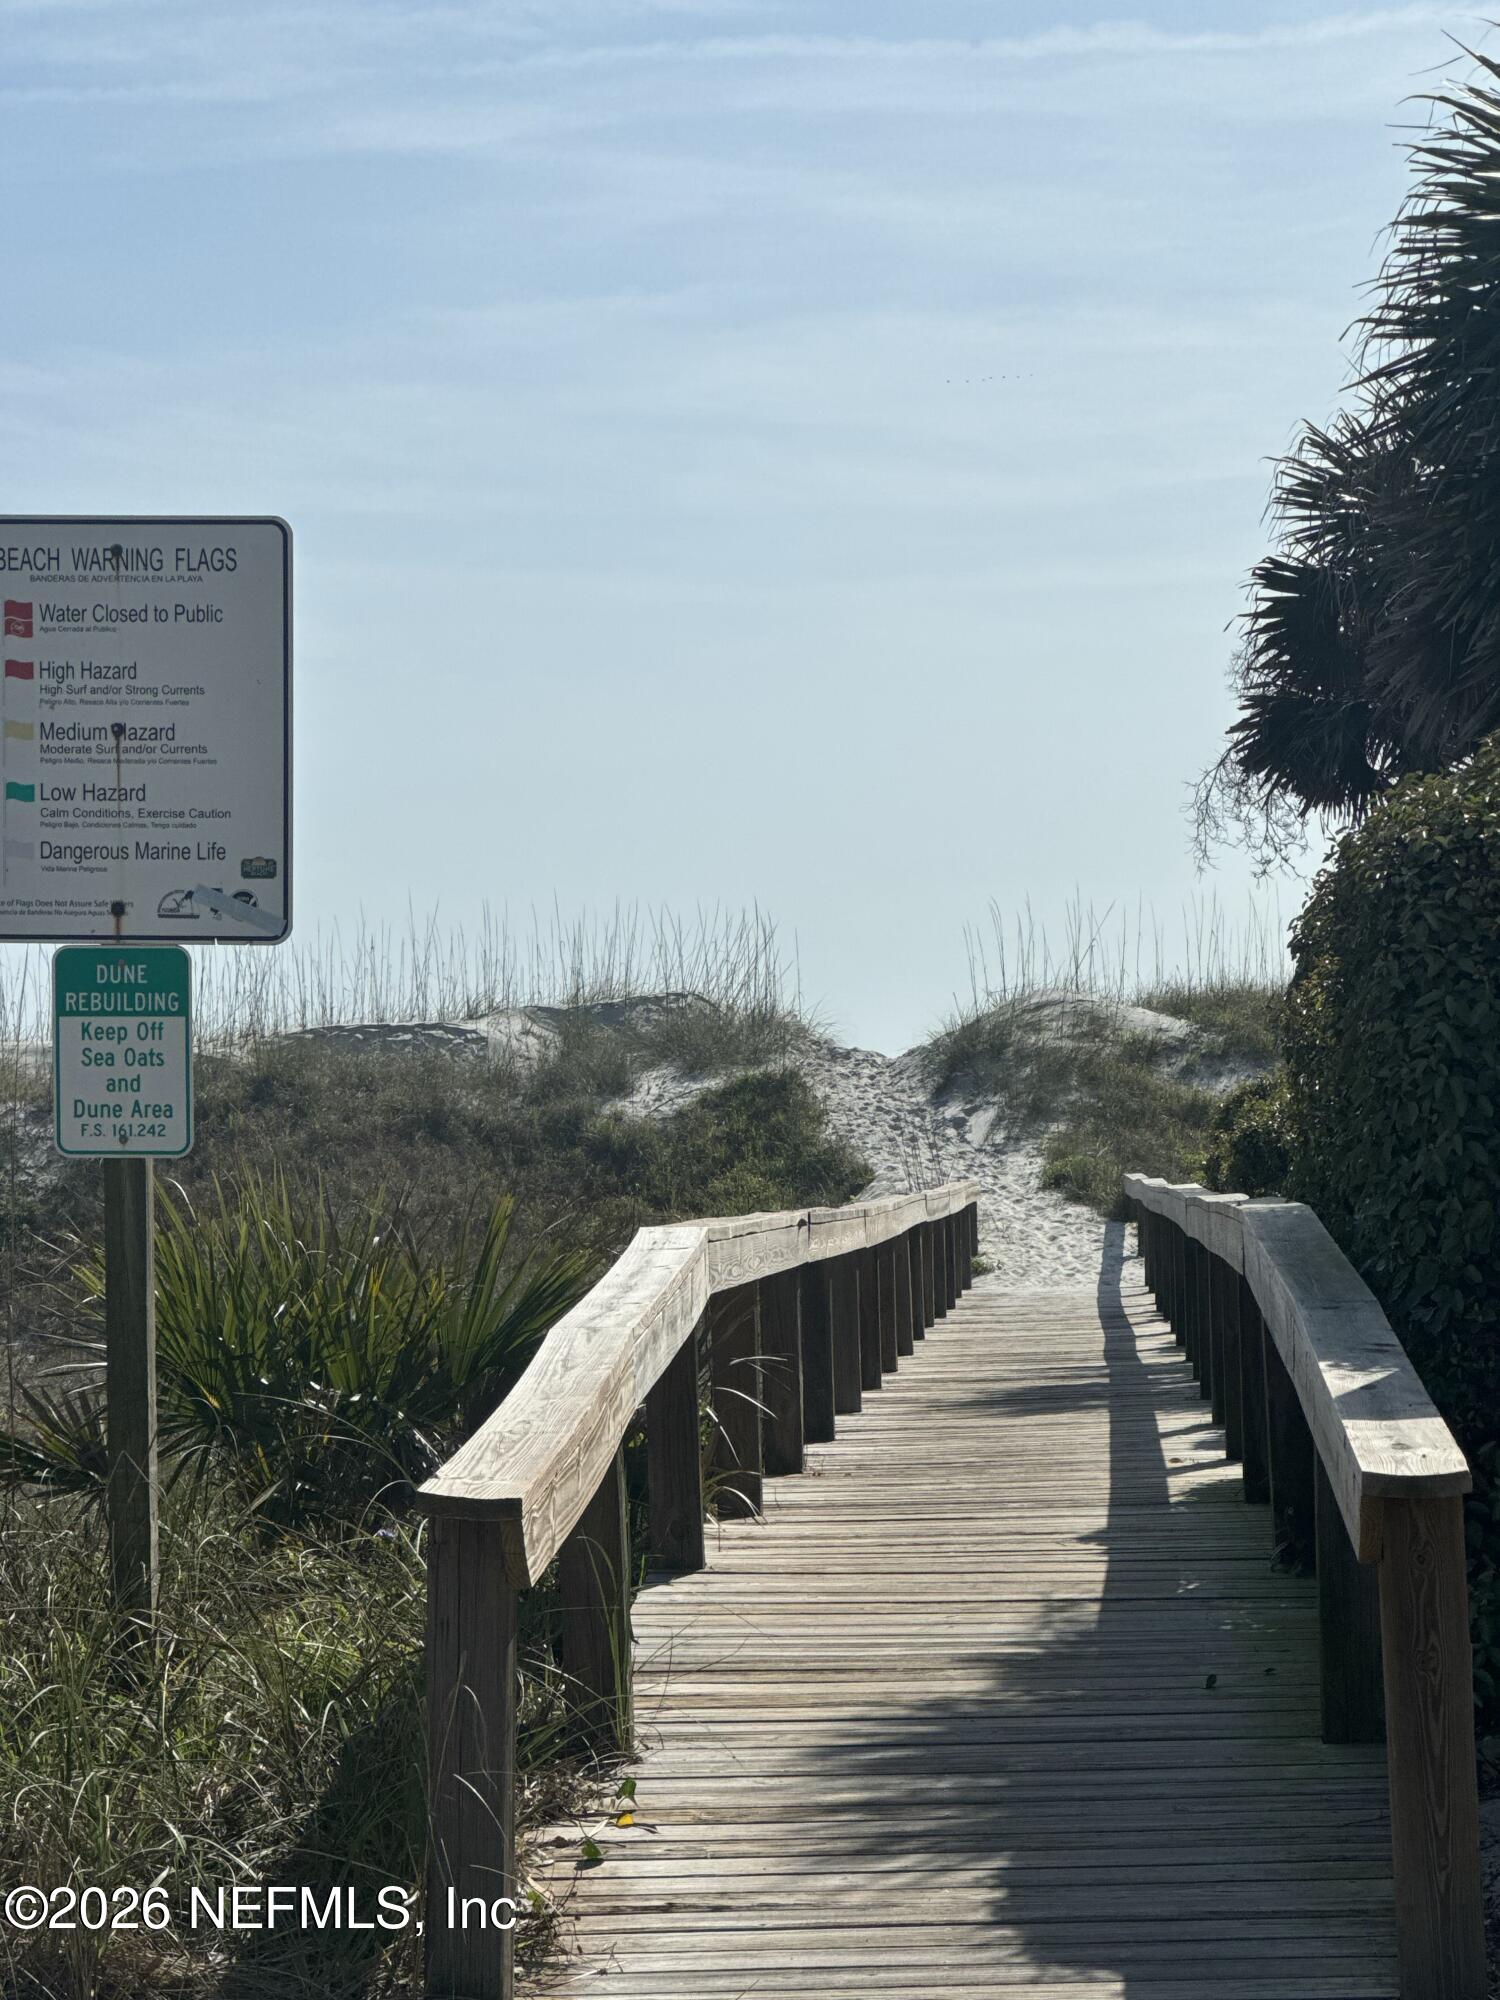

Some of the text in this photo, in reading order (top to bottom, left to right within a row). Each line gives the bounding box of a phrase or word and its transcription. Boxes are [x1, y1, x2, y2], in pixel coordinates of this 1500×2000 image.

[0, 547, 237, 572] BEACH WARNING FLAGS
[29, 575, 76, 583] BANDERAS
[78, 575, 89, 583] DE
[152, 575, 163, 583] EN
[165, 575, 176, 583] LA
[177, 575, 203, 583] PLAYA
[39, 604, 223, 622] Water Closed to Public
[39, 661, 137, 684] High Hazard
[39, 685, 205, 697] High Surf and/or Strong Currents
[39, 722, 107, 741] Medium
[39, 745, 92, 754] Moderate
[122, 745, 157, 754] and/or
[160, 745, 208, 754] Currents
[39, 783, 146, 802] Low Hazard
[40, 808, 231, 820] Calm Conditions, Exercise Caution
[40, 841, 226, 864] Dangerous Marine Life
[96, 965, 148, 984] DUNE
[65, 992, 179, 1012] REBUILDING
[81, 1021, 164, 1044] Keep Off
[81, 1048, 165, 1067] Sea Oats
[106, 1074, 141, 1093] and
[73, 1099, 173, 1119] Dune Area
[81, 1124, 166, 1137] F.S. 161.242
